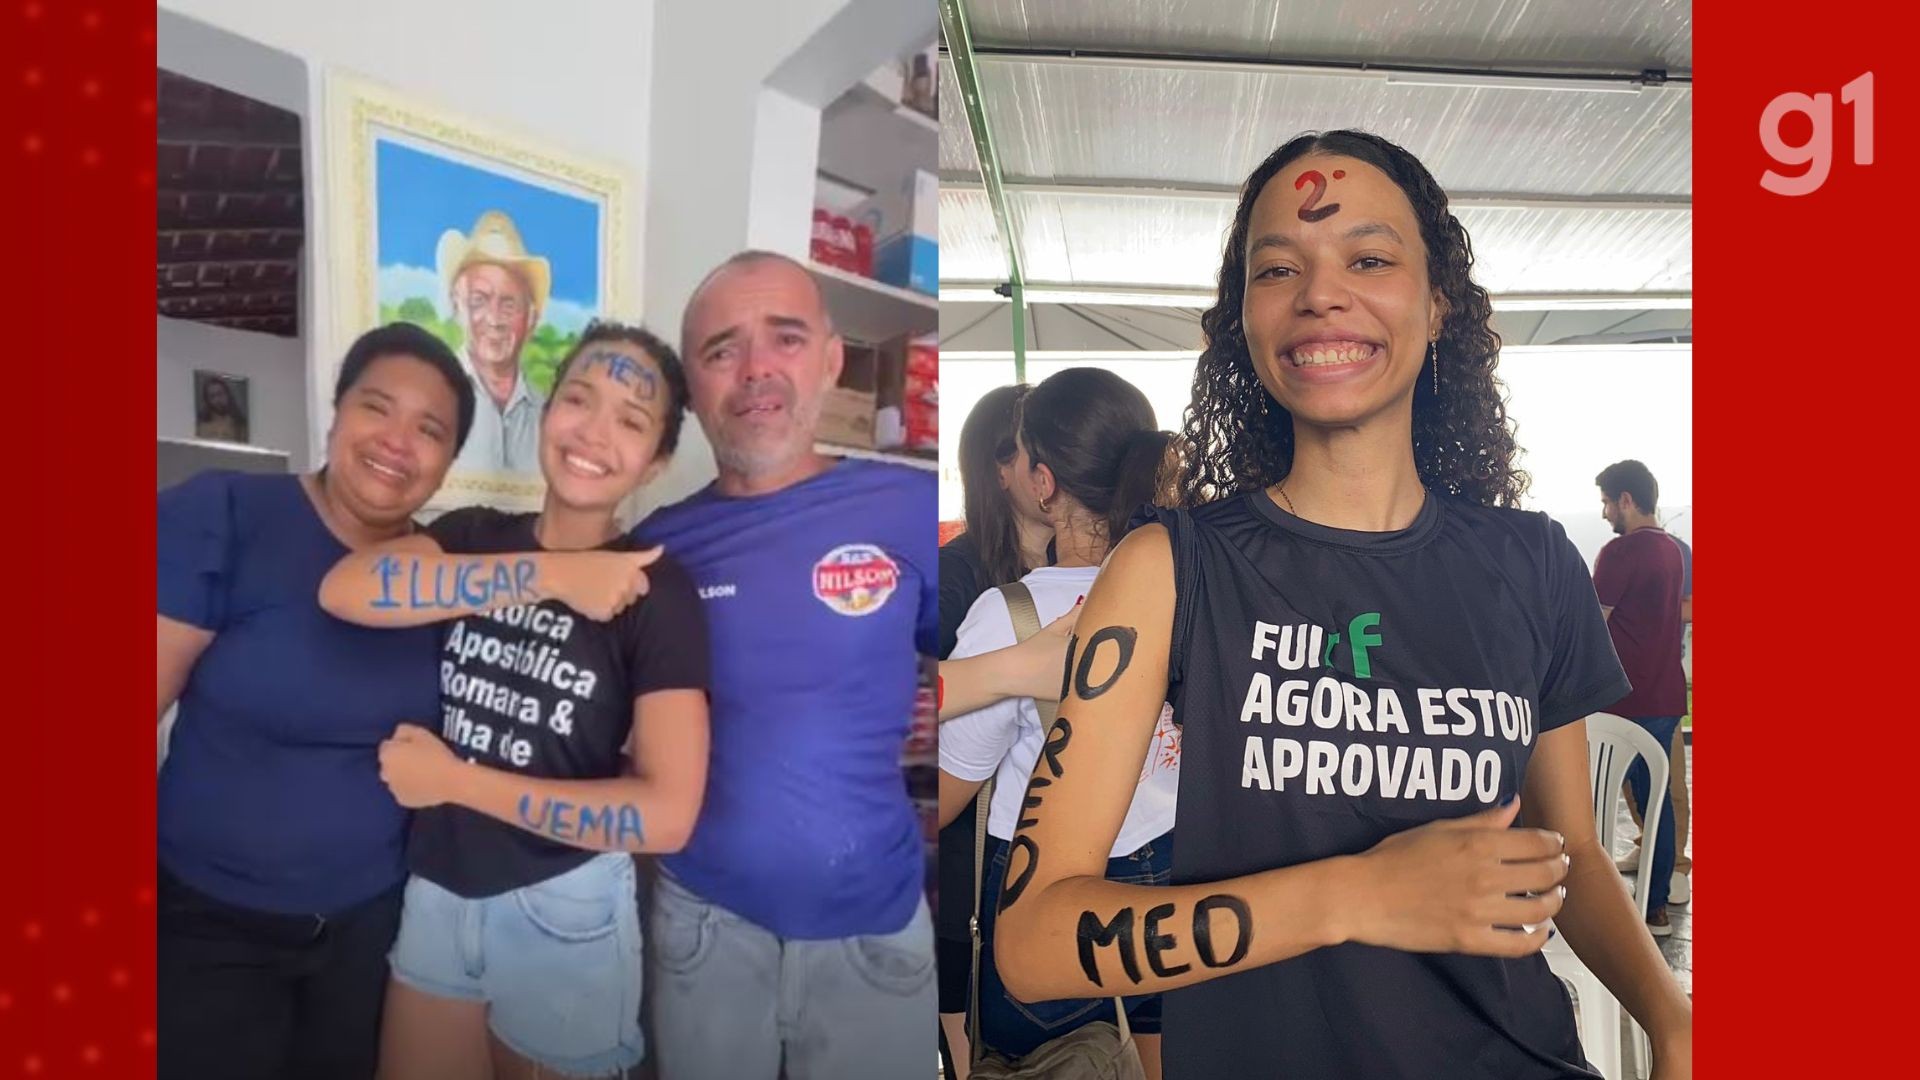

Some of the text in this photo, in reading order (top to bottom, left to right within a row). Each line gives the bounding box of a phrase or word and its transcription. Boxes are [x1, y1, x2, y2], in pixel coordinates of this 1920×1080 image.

[410, 559, 538, 608] LUGAR
[1251, 620, 1323, 670] FUI
[442, 702, 493, 752] ilha
[1240, 672, 1532, 746] AGORA ESTOU
[1241, 736, 1502, 804] APROVADO
[518, 793, 645, 847] UEMA
[1077, 894, 1254, 988] MED
